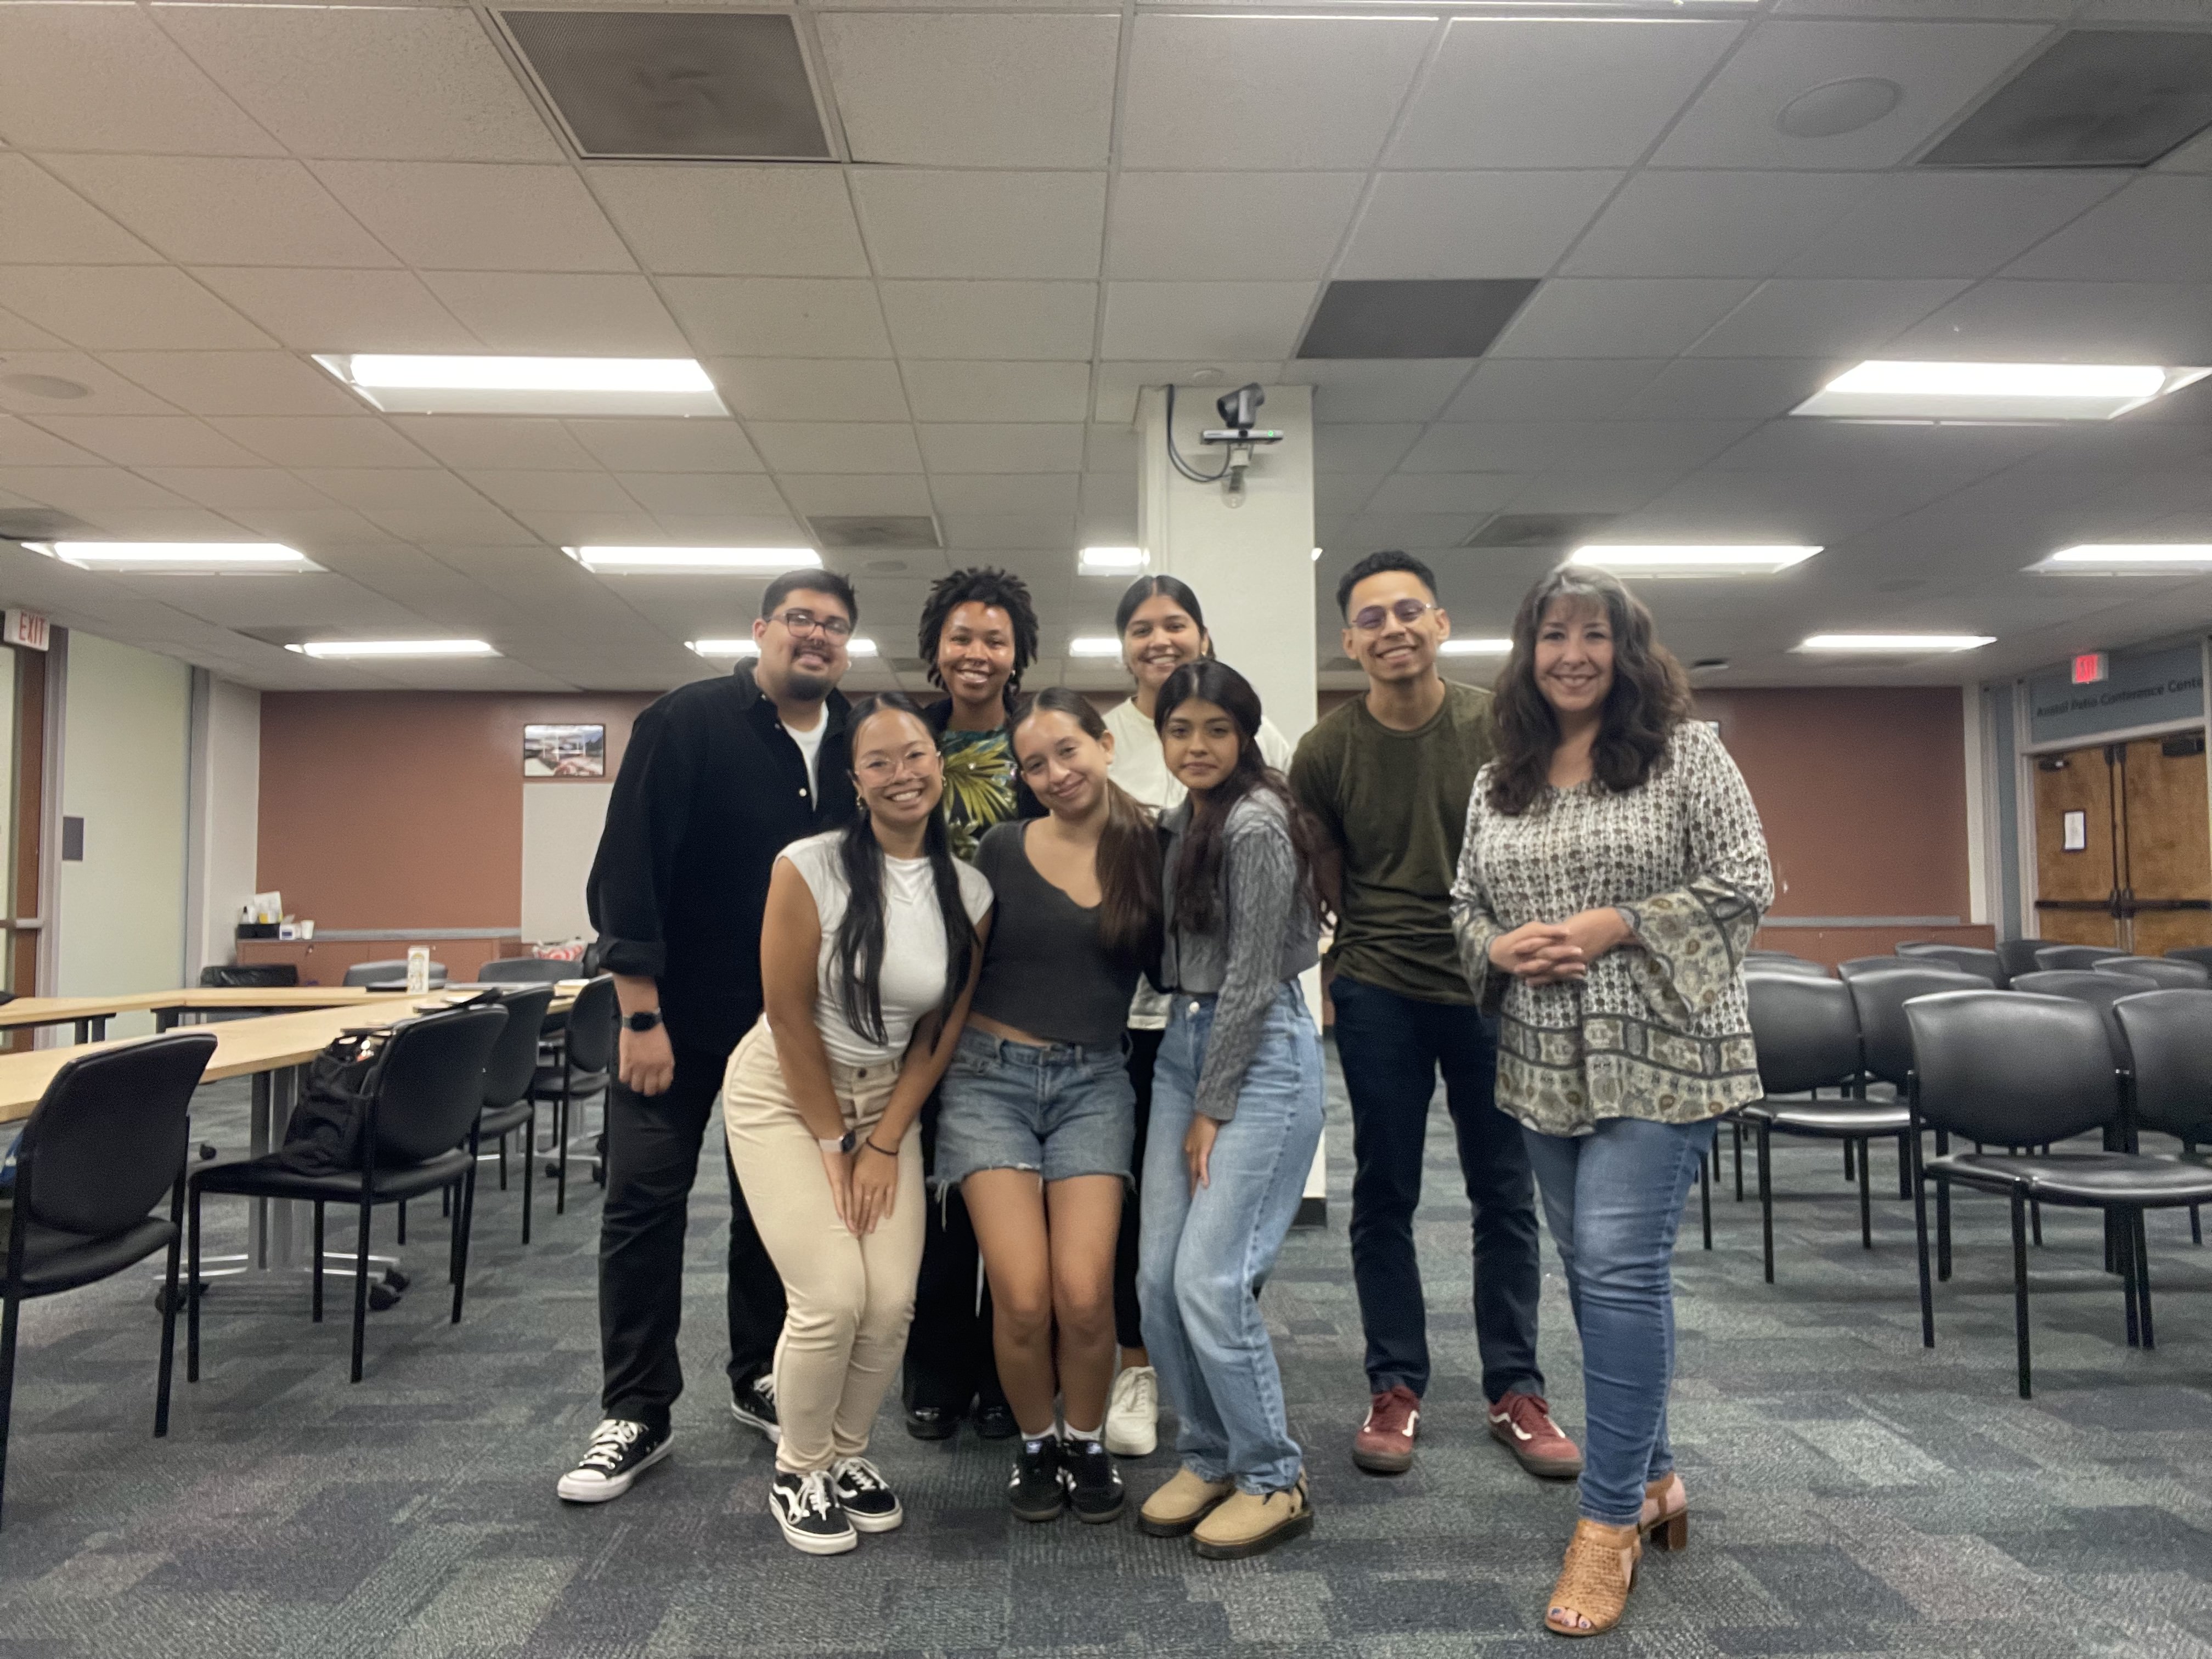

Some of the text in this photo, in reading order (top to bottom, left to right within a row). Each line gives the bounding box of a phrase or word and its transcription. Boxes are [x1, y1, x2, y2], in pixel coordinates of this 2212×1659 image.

[19, 612, 44, 646] EXIT
[2101, 686, 2164, 706] Conference
[2168, 678, 2203, 693] Cente
